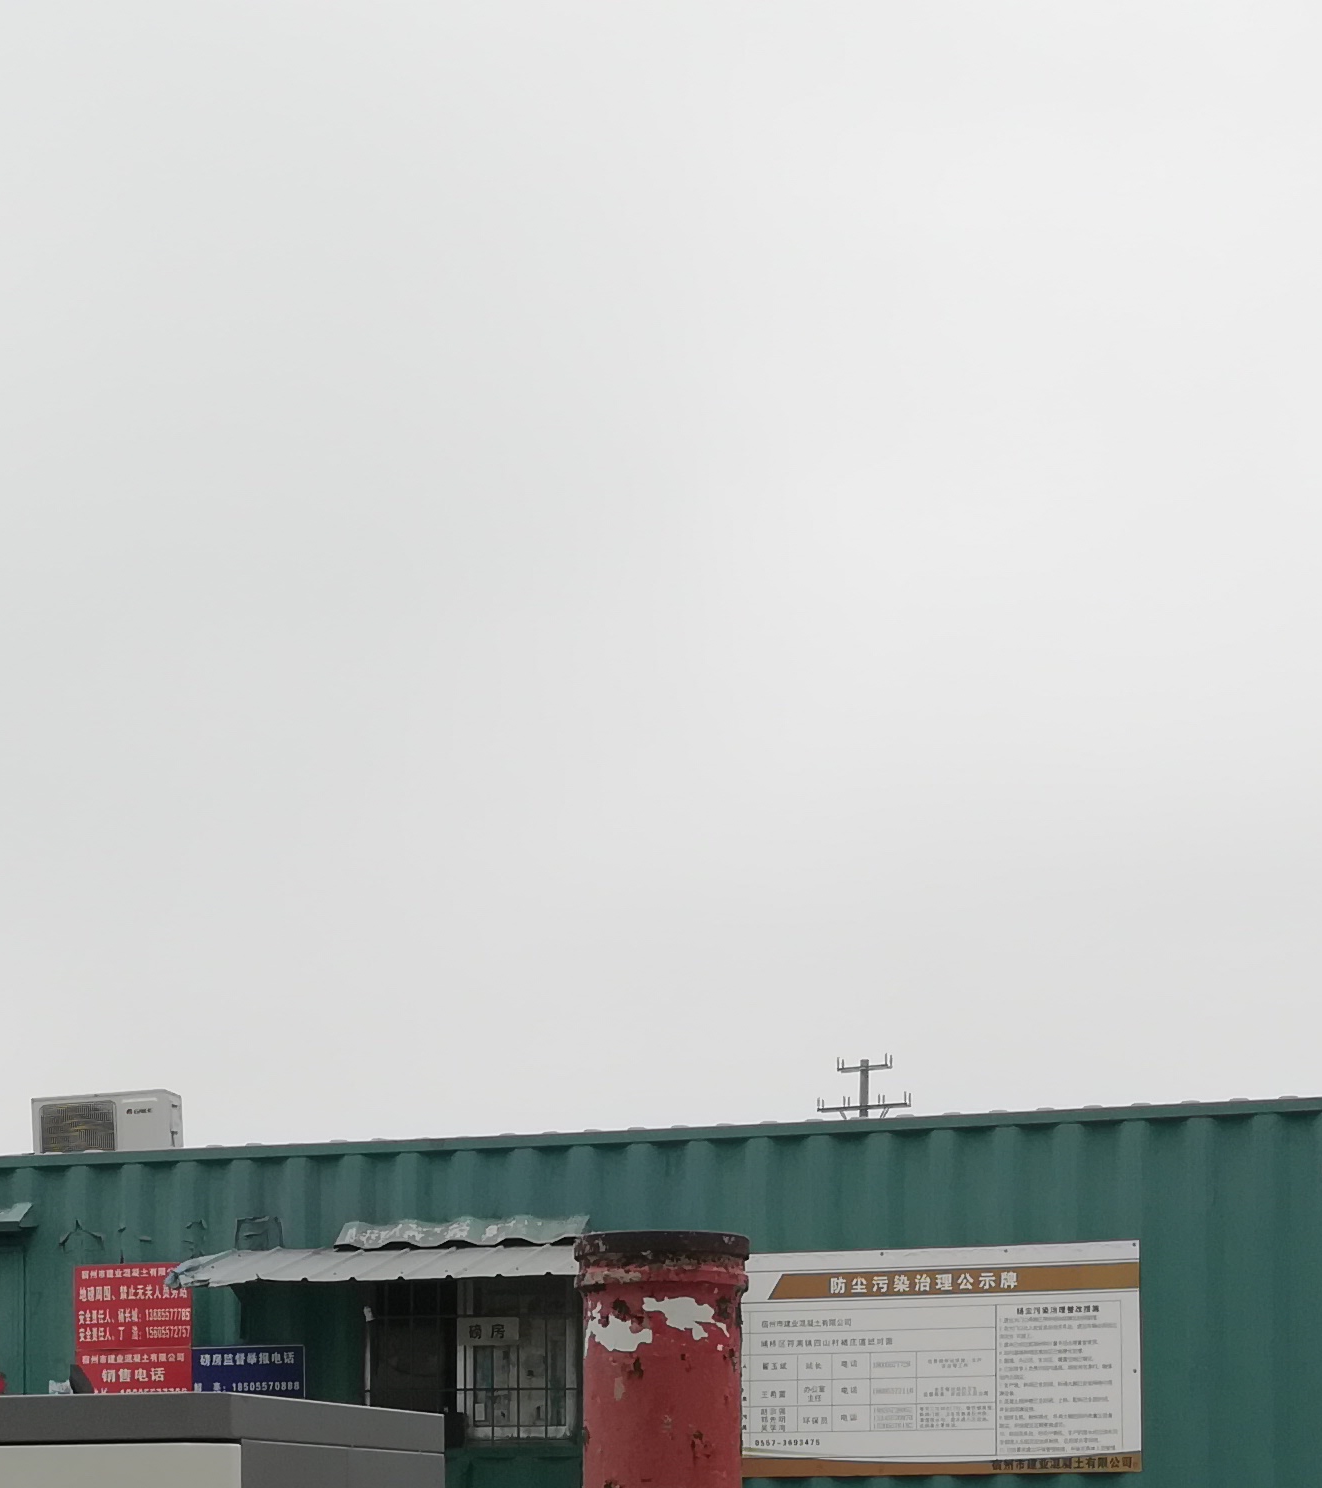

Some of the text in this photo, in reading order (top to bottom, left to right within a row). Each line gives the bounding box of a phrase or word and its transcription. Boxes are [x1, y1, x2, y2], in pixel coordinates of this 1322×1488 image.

[829, 1272, 1018, 1295] 防尘污染治理公示牌
[468, 1323, 506, 1339] 磅房
[101, 1367, 166, 1383] 销售电话
